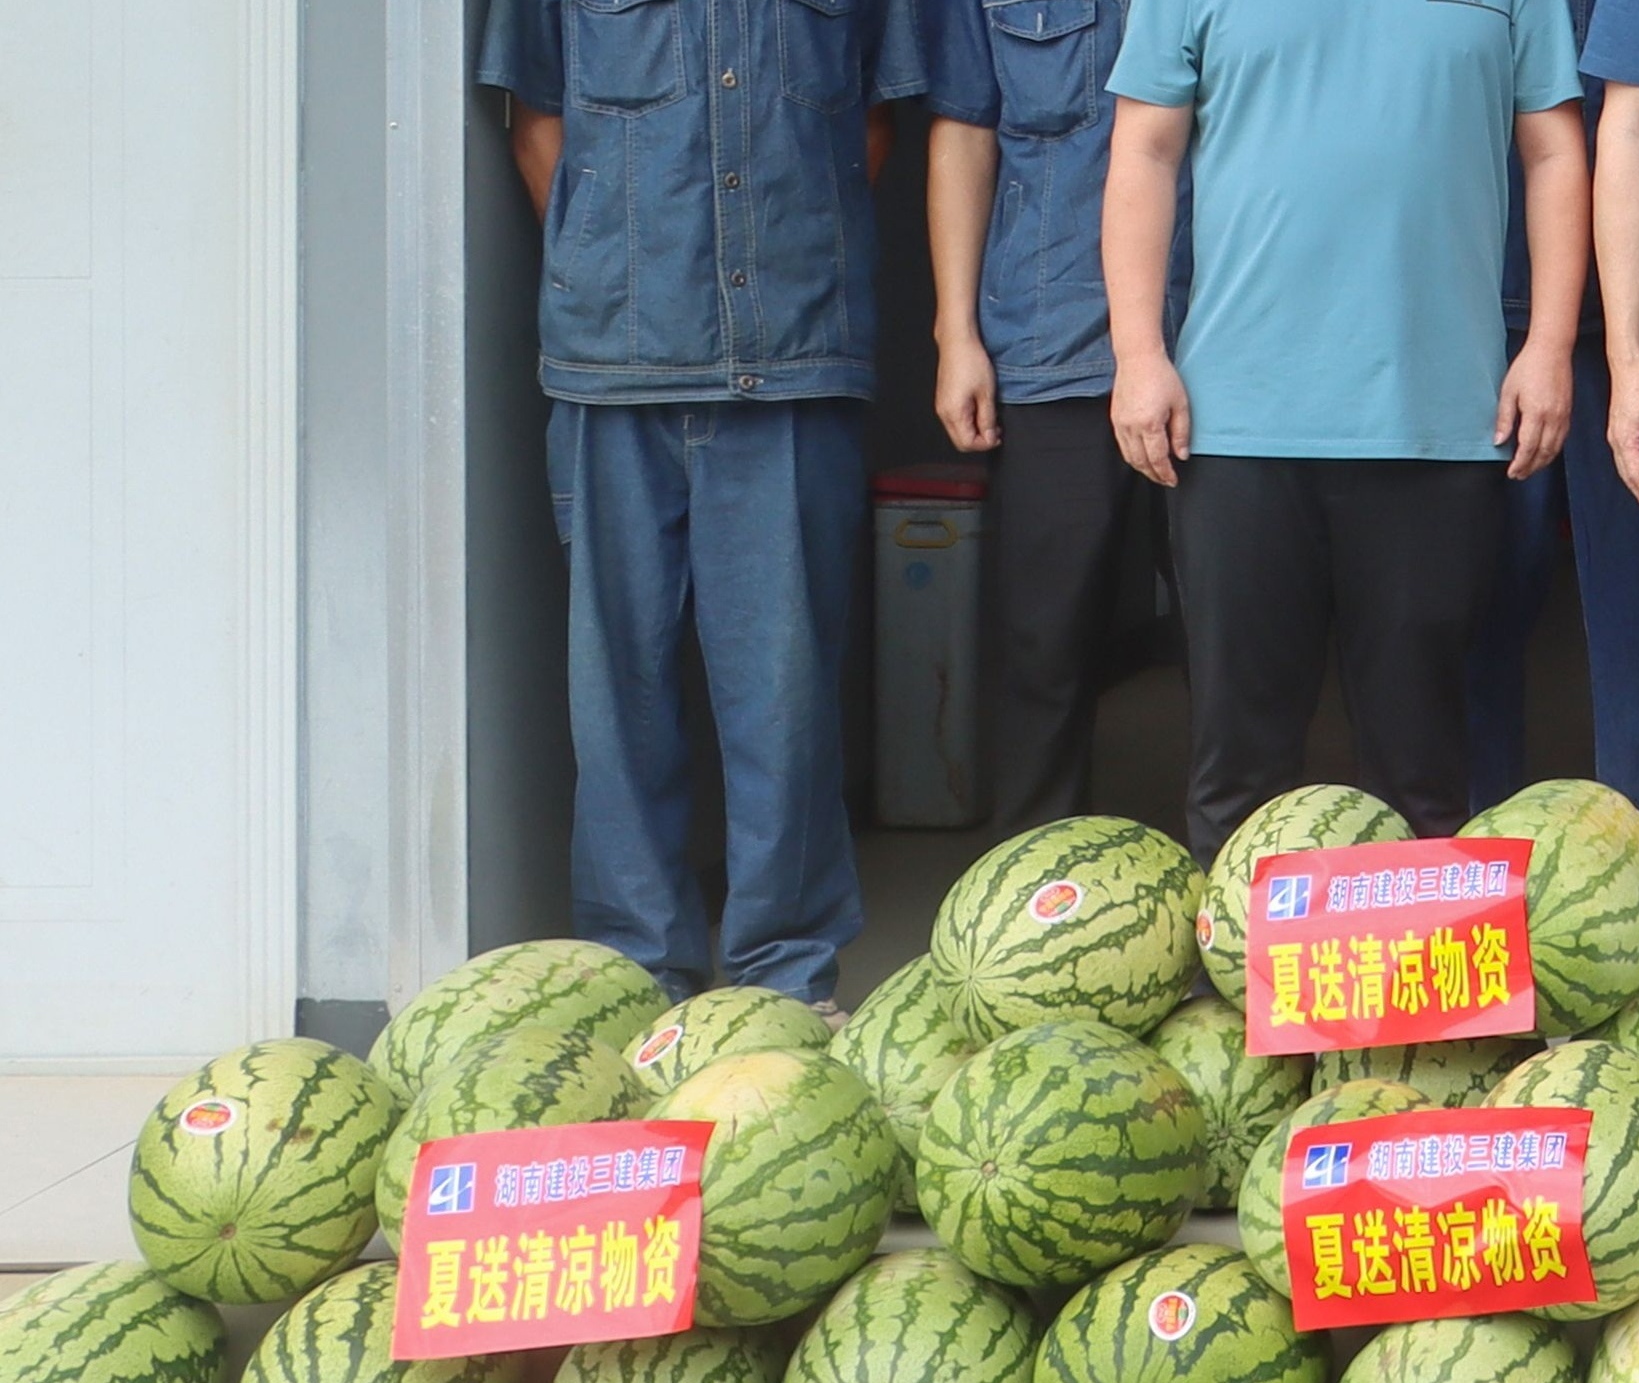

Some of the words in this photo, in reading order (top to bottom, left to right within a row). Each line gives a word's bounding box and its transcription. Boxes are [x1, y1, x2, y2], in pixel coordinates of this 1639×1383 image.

[1328, 862, 1508, 911] 湖南建投三建集团
[1269, 924, 1511, 1025] 夏送清凉物资
[495, 1147, 685, 1206] 湖南建投三建集团
[1367, 1132, 1566, 1179] 湖南建投三建集团
[421, 1216, 679, 1328] 夏送清凉物资
[1306, 1199, 1565, 1298] 夏送清凉物资
